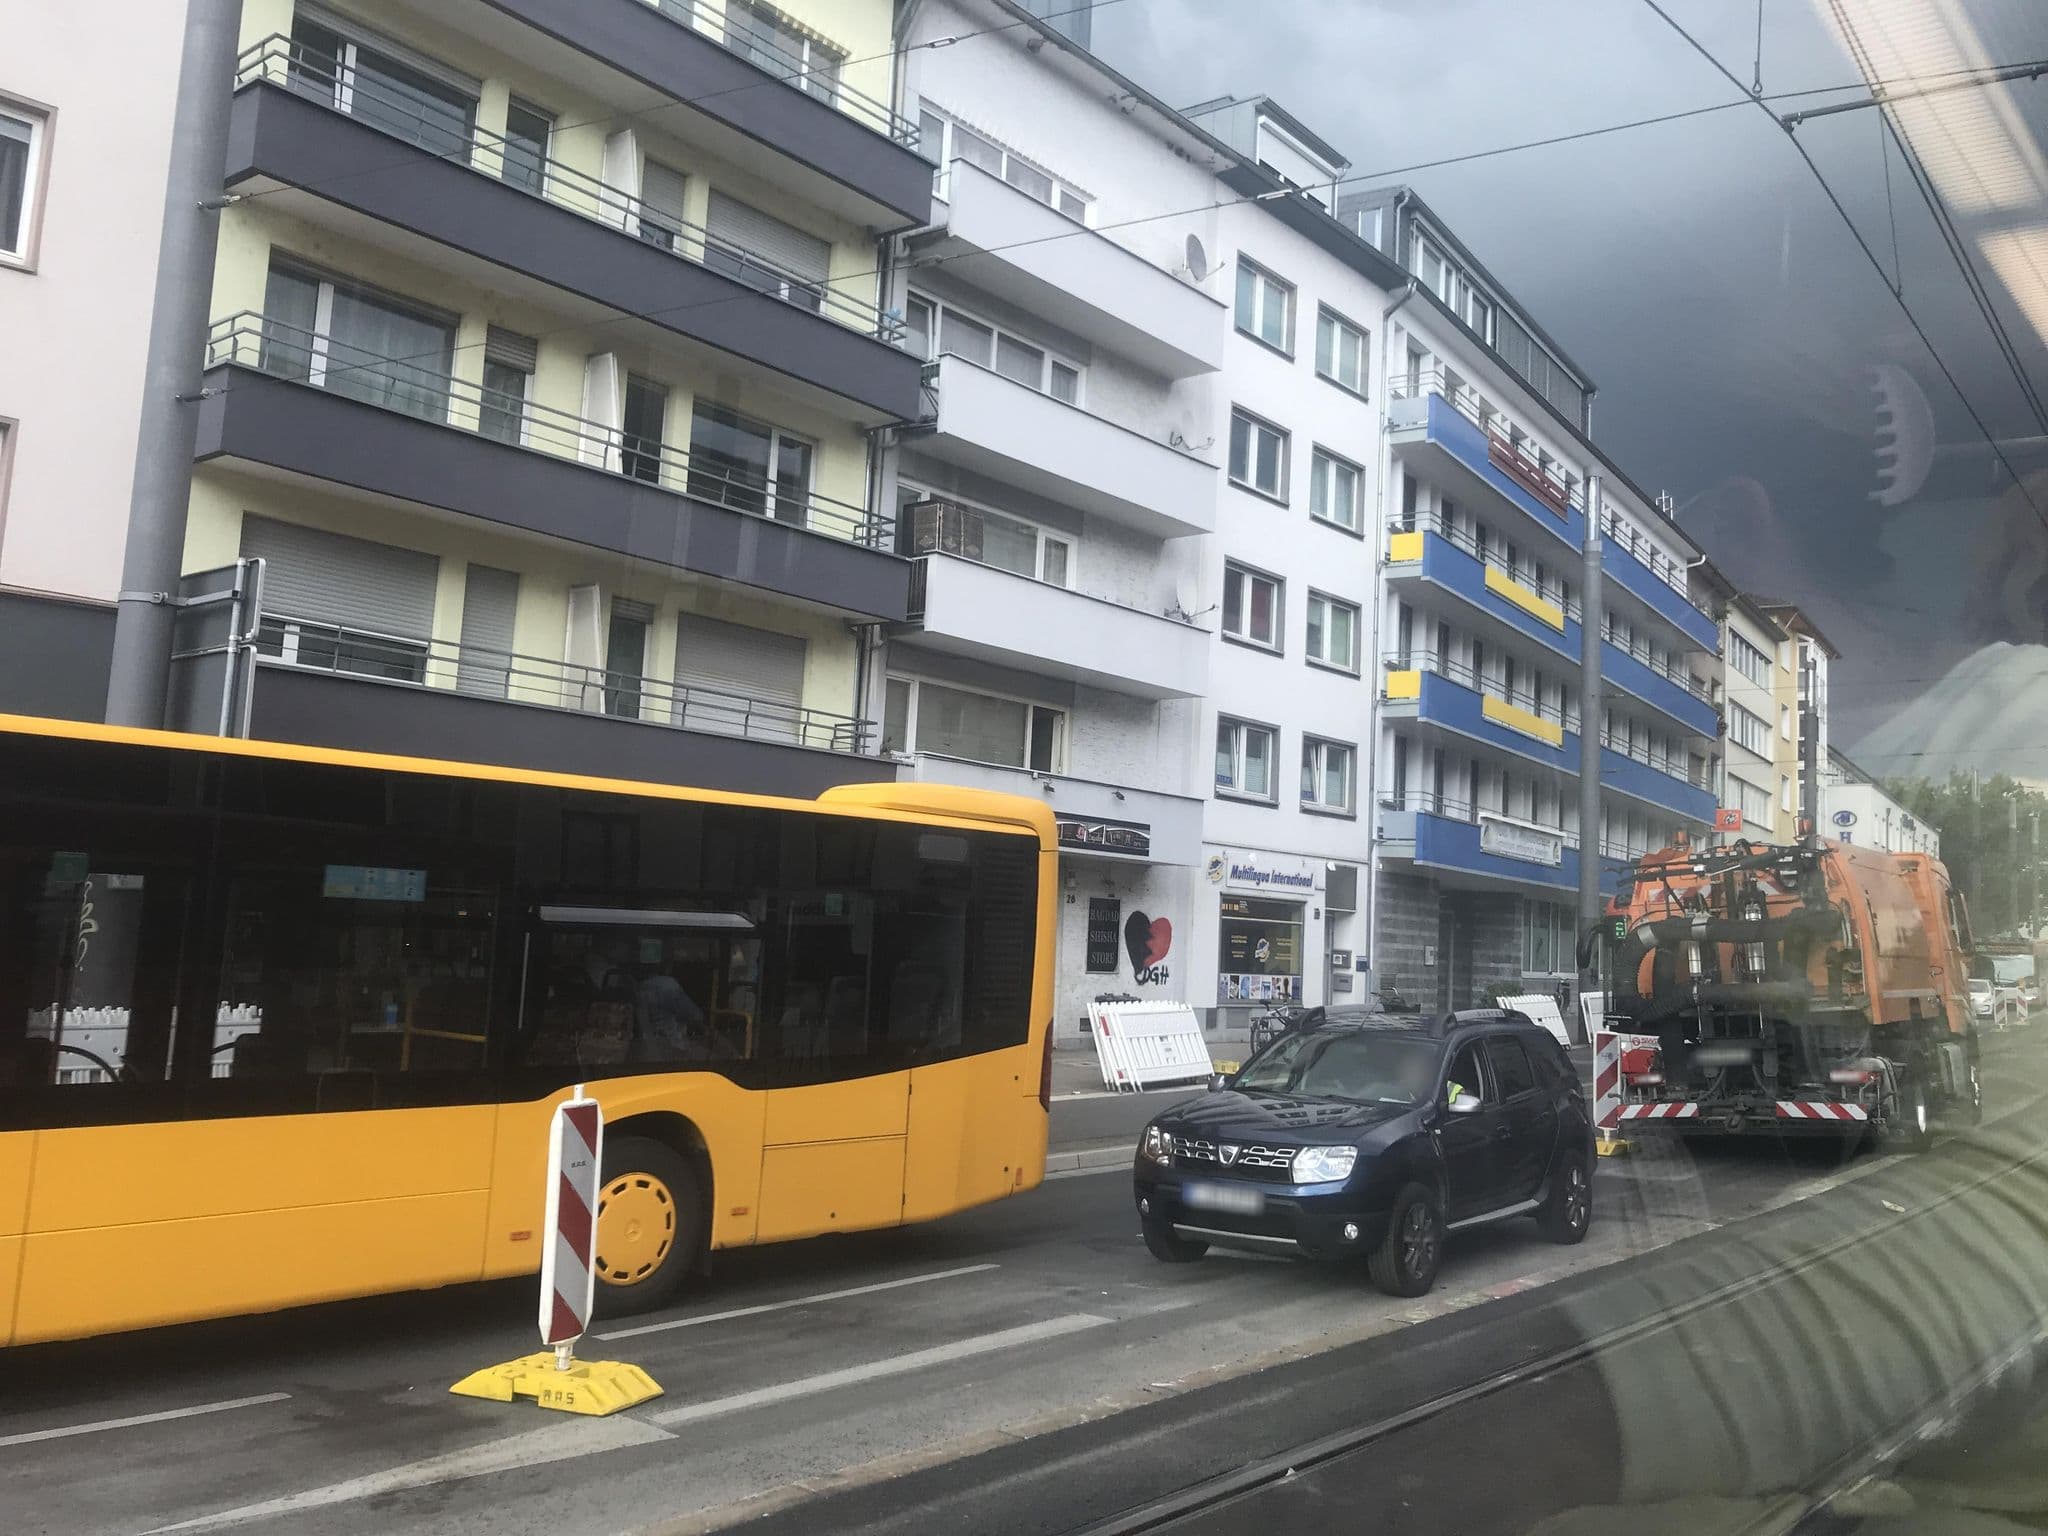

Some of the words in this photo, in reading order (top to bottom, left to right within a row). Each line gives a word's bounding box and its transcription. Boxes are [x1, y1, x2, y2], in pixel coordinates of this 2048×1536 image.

[1231, 865, 1269, 886] Multilingua
[1271, 869, 1314, 888] International
[1091, 952, 1115, 965] STORE
